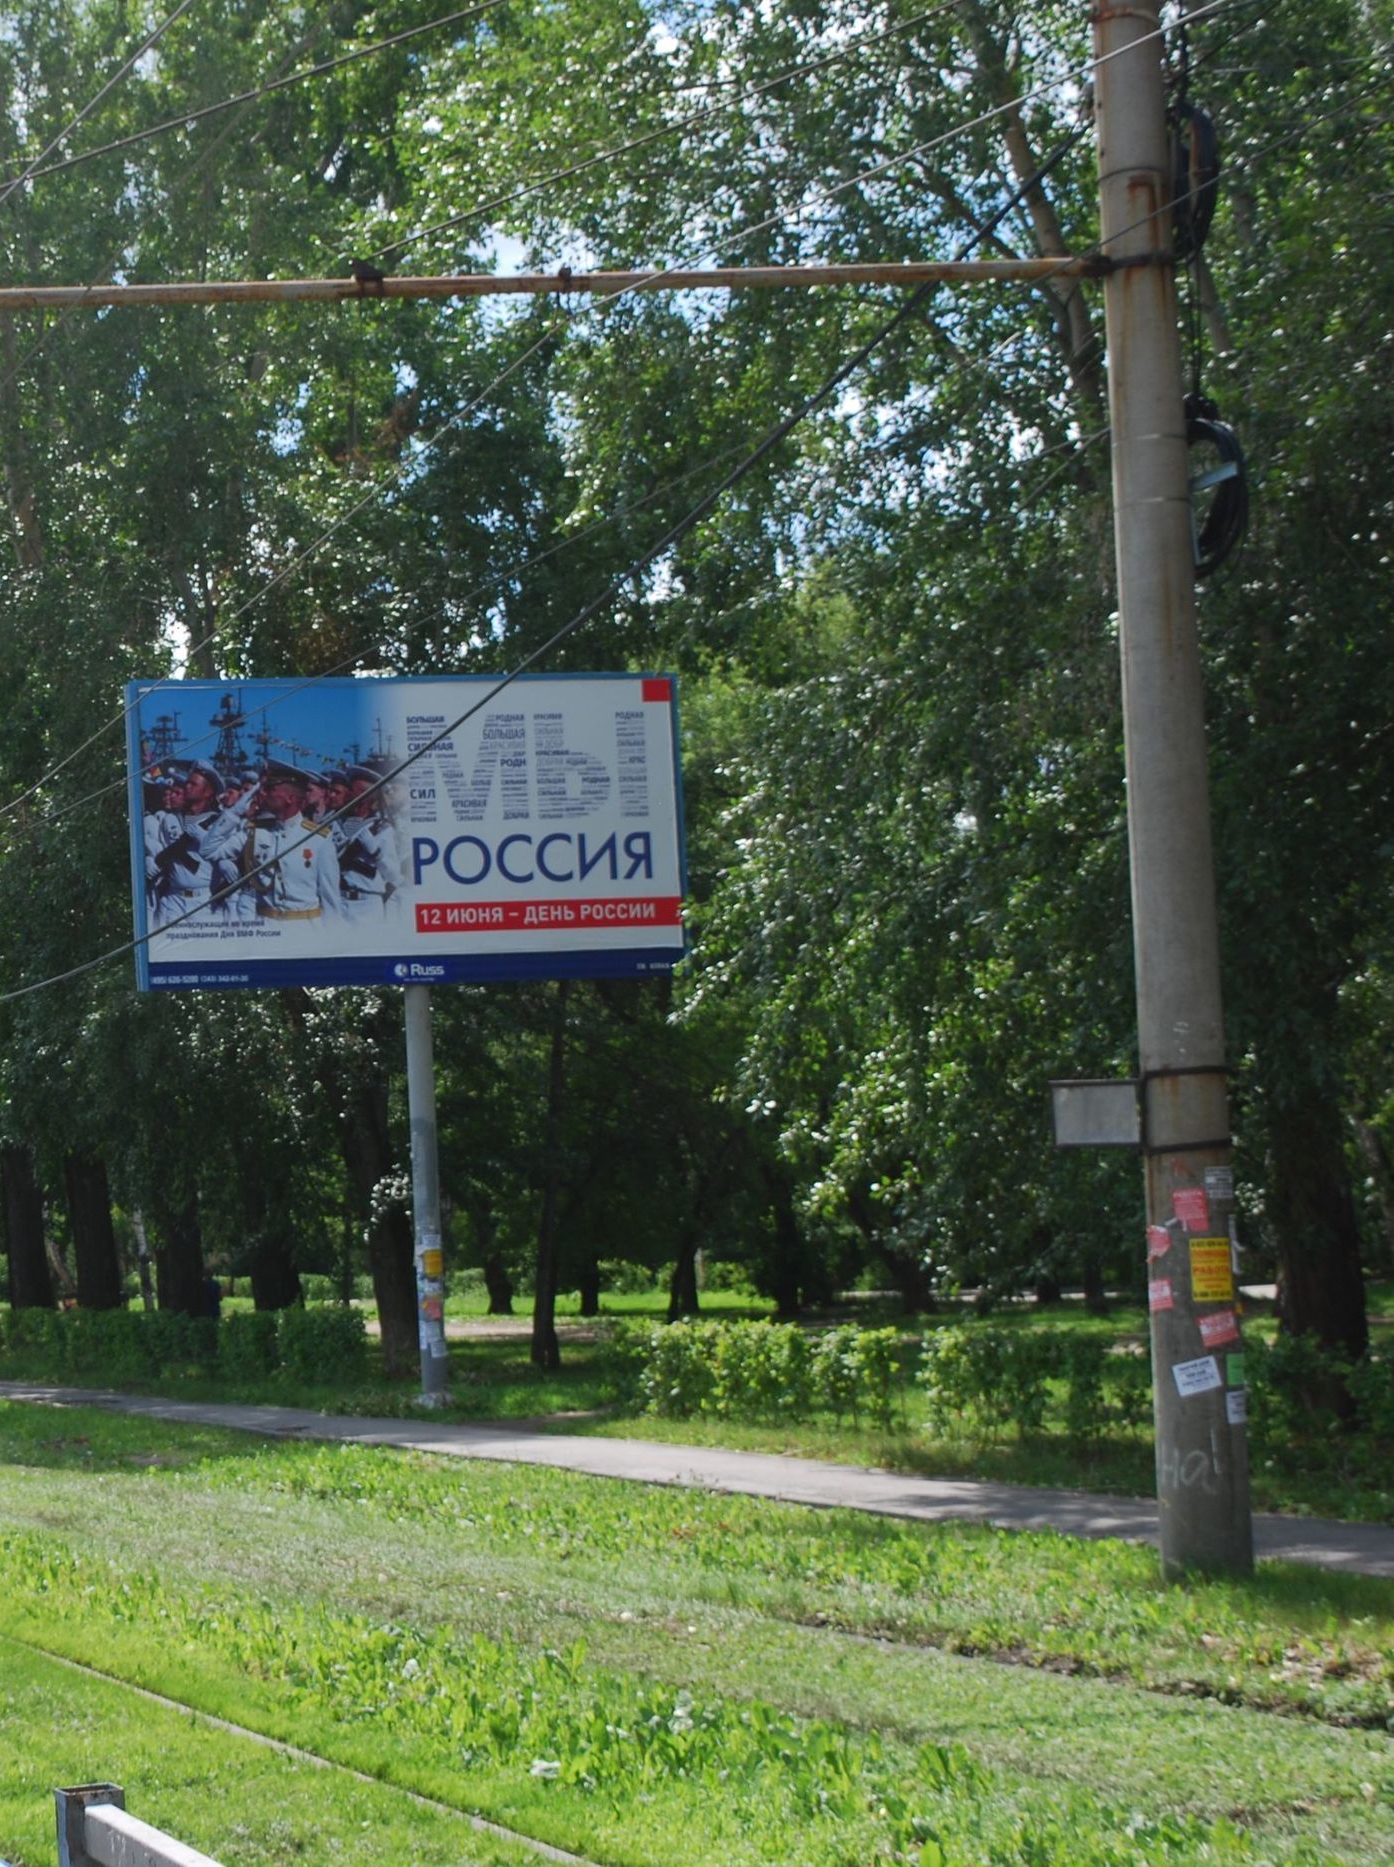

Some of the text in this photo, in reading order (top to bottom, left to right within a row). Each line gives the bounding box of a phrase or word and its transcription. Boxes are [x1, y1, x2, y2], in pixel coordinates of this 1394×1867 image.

[482, 728, 526, 740] БОЛЬШАЯ
[500, 759, 526, 768] РОДН
[410, 789, 436, 800] СИЛ
[412, 831, 654, 885] РОССИЯ
[420, 908, 441, 925] 12
[446, 907, 504, 924] ИЮНЯ
[523, 904, 575, 925] ДЕНЬ
[580, 903, 656, 920] РОССИИ
[166, 932, 218, 940] празднования
[220, 930, 235, 939] Дня
[410, 963, 445, 976] Russ
